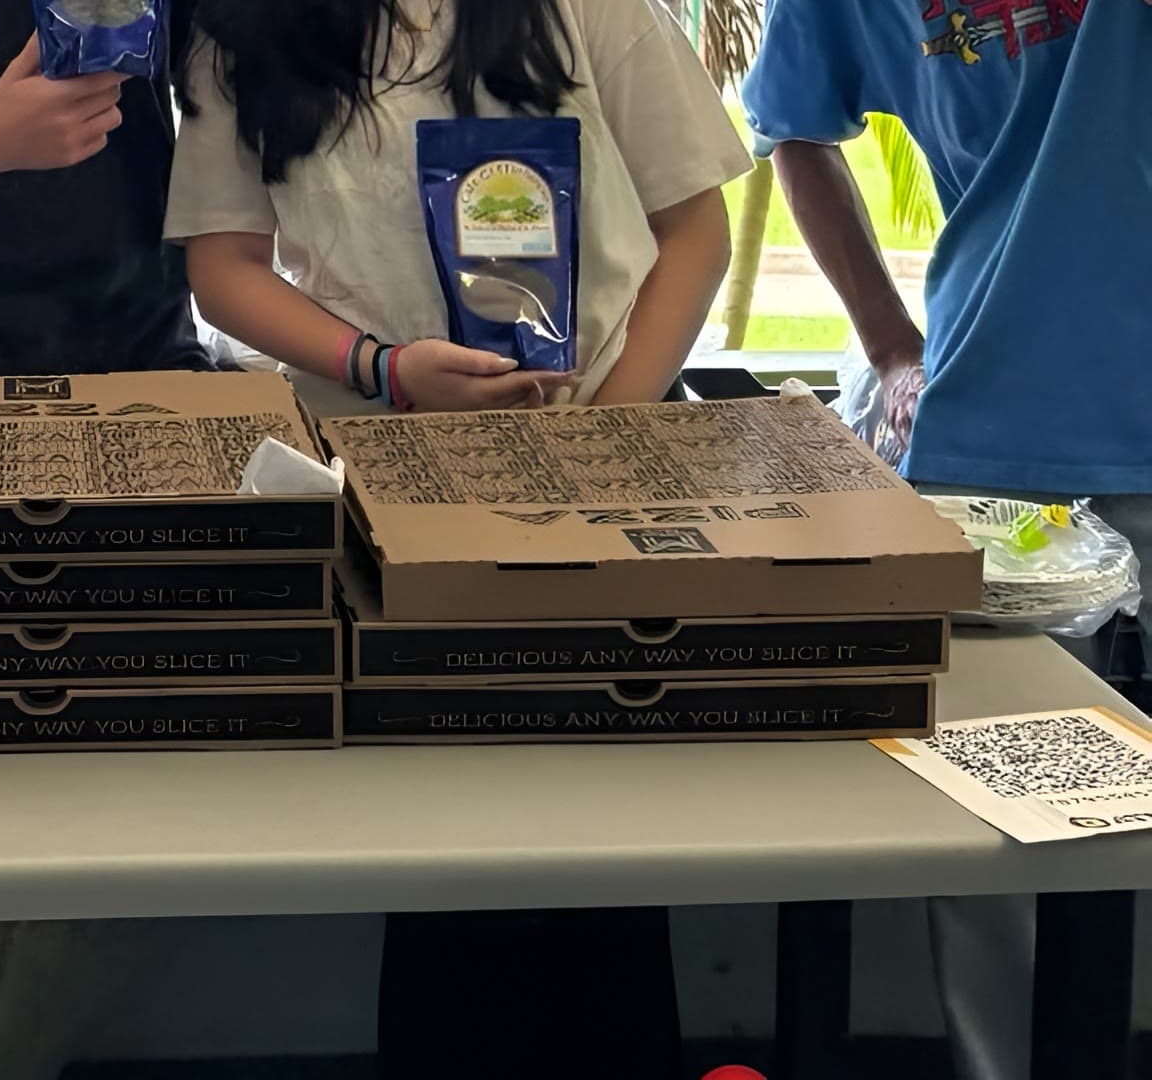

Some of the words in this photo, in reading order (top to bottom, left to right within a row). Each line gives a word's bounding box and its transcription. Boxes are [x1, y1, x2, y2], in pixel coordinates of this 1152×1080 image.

[489, 499, 811, 526] PIZZA
[35, 530, 85, 545] WAY
[96, 528, 145, 544] YOU
[151, 528, 222, 543] SLICE
[229, 527, 248, 543] IT
[24, 589, 77, 604] WAY
[85, 588, 135, 604] YOU
[141, 588, 211, 603] SLICE
[218, 588, 236, 603] IT
[36, 656, 87, 671] WAY
[96, 655, 145, 670] YOU
[153, 654, 222, 669] SLICE
[229, 653, 248, 669] IT
[446, 651, 572, 667] DELICIOUS
[580, 649, 635, 665] ANY
[643, 648, 695, 664] WAY
[704, 647, 754, 662] YOU
[837, 645, 857, 660] IT
[35, 720, 86, 736] WAY
[95, 719, 145, 735] YOU
[228, 718, 248, 734] IT
[431, 711, 556, 728] DELICIOUS
[563, 711, 617, 727] ANY
[627, 710, 681, 727] WAY
[688, 710, 739, 726] YOU
[822, 709, 844, 724] IT
